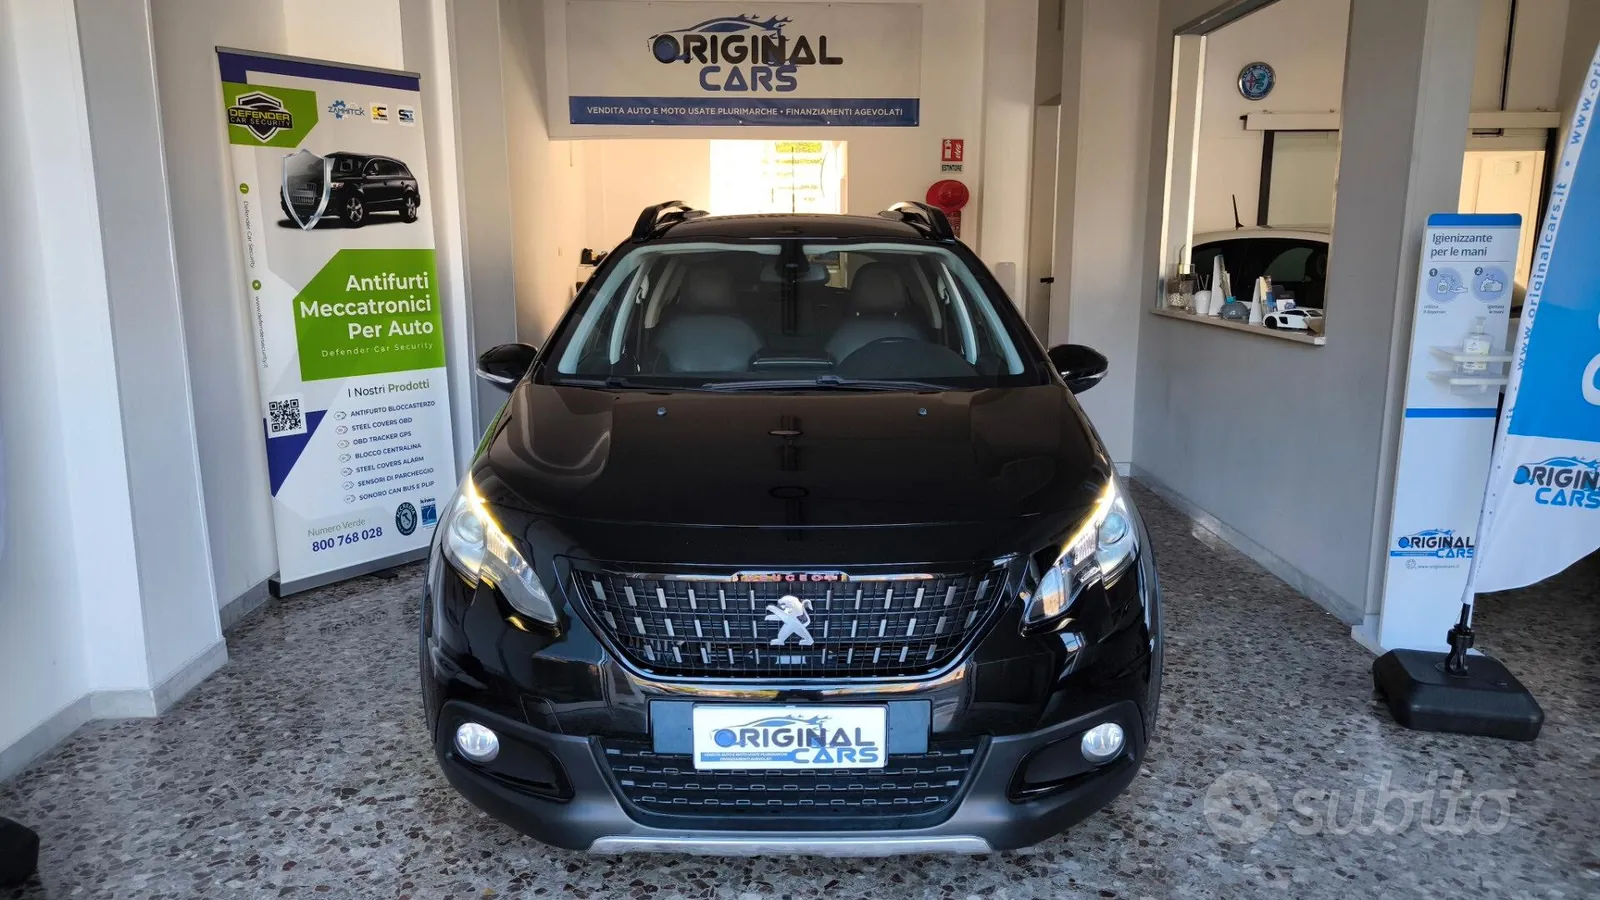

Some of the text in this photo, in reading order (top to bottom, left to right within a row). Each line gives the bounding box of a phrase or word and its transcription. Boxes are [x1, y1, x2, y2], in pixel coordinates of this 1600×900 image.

[652, 34, 844, 65] ORIGINAL
[700, 66, 798, 92] CARS
[229, 109, 290, 121] DEFENDER
[587, 106, 903, 116] VENDITA AUTO E MOTO USATE PLURIMARCHE FINANZIAMENTI AGEVOLATI
[230, 116, 291, 127] CAR SECURITY
[1432, 233, 1493, 245] Igienizzante
[1430, 247, 1488, 259] per le mani
[346, 272, 429, 292] Antifurti
[1517, 183, 1567, 371] www.originalcars.it
[300, 295, 431, 318] Meccatronici
[348, 320, 433, 339] Per Auto
[321, 342, 433, 357] Defender Car Security
[354, 385, 386, 397] Nostri
[388, 379, 430, 393] Prodotti
[350, 401, 436, 417] ANTIFURTO BLOCCASTERZO
[373, 420, 398, 428] COVERS
[353, 437, 368, 445] OBD
[369, 433, 398, 442] TRACKER
[355, 443, 422, 459] BLOCCO CENTRALINA
[356, 456, 424, 473] STEEL COVERS ALARM
[358, 476, 386, 487] SENSORI
[395, 468, 435, 480] PARCHEGGIO
[1513, 465, 1600, 490] ORIGIN
[359, 490, 387, 501] SONORO
[388, 487, 402, 495] CAN
[403, 484, 416, 492] BUS
[1535, 488, 1600, 509] CARS
[308, 518, 366, 537] Numero Verde
[312, 527, 383, 552] 800 768 028
[1398, 537, 1474, 548] ORIGINAL
[1437, 548, 1474, 558] CARS
[714, 728, 875, 748] ORIGINAL
[793, 747, 878, 764] CARS
